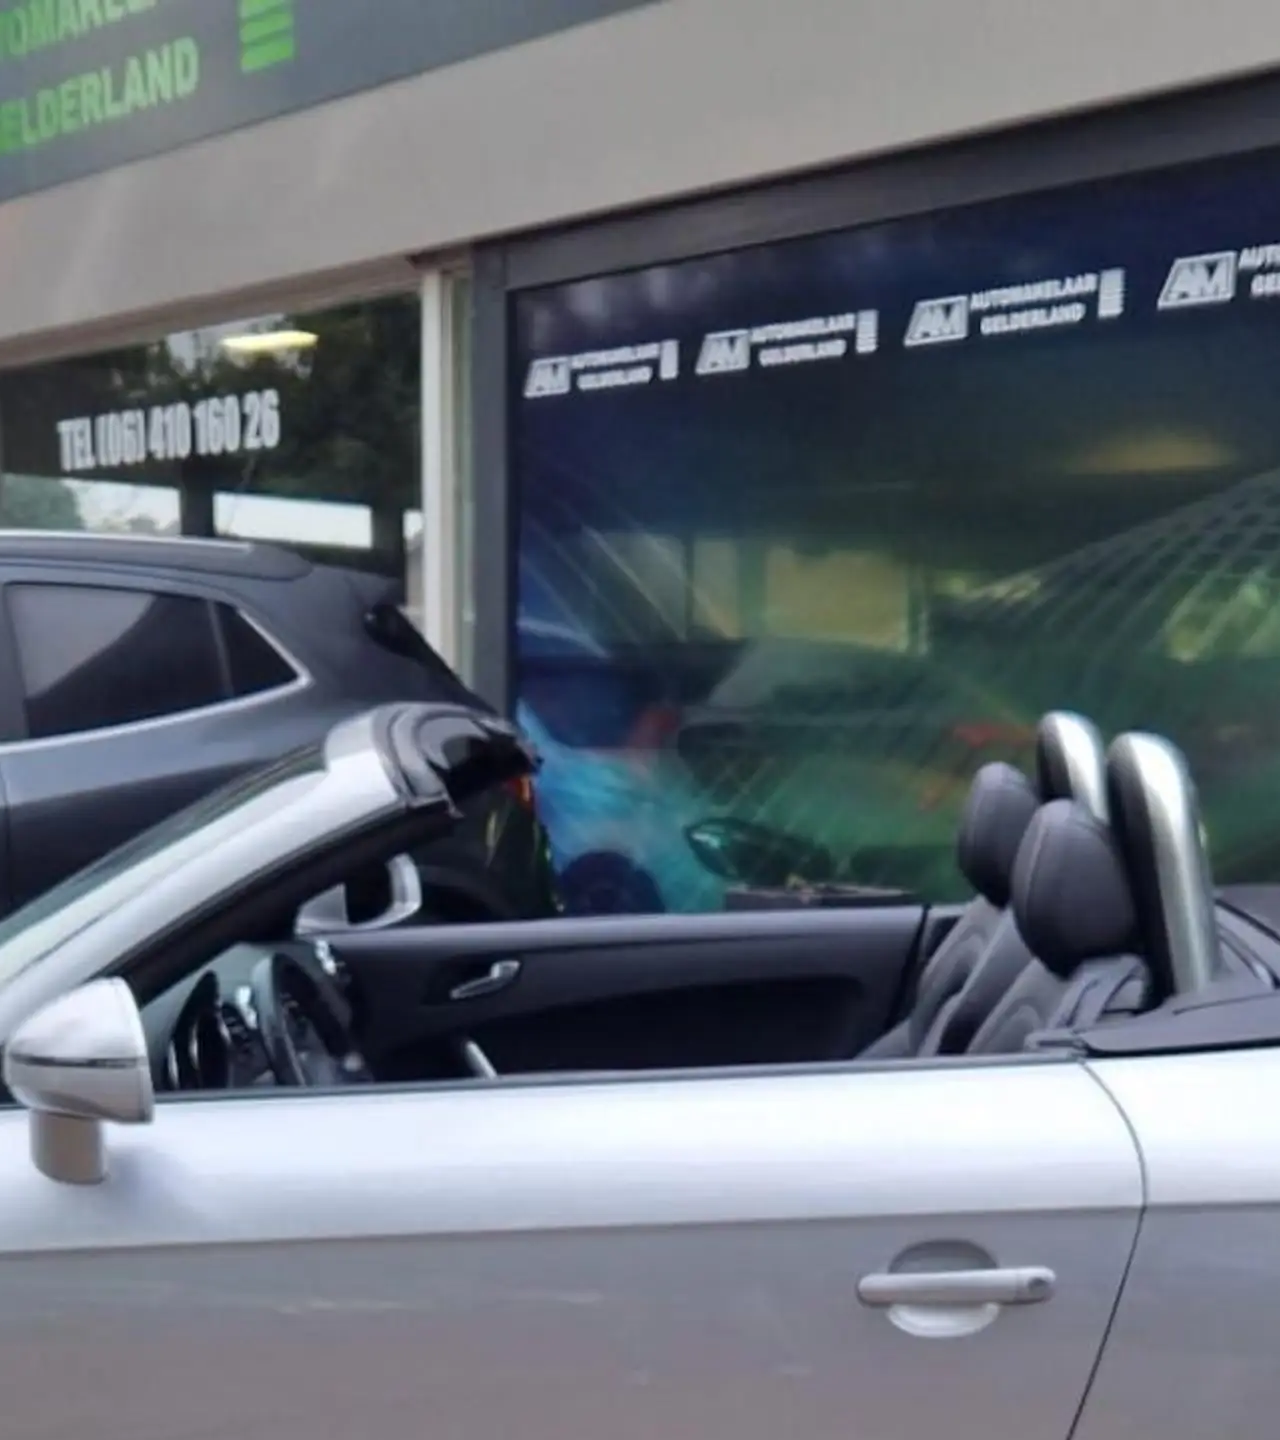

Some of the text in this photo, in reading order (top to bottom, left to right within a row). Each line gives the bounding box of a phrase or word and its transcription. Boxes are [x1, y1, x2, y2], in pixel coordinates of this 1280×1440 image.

[1160, 254, 1235, 306] AM
[907, 298, 968, 343] AM
[57, 417, 96, 471] TEL
[149, 402, 191, 459] 410
[193, 394, 241, 455] 160
[243, 389, 280, 449] 26
